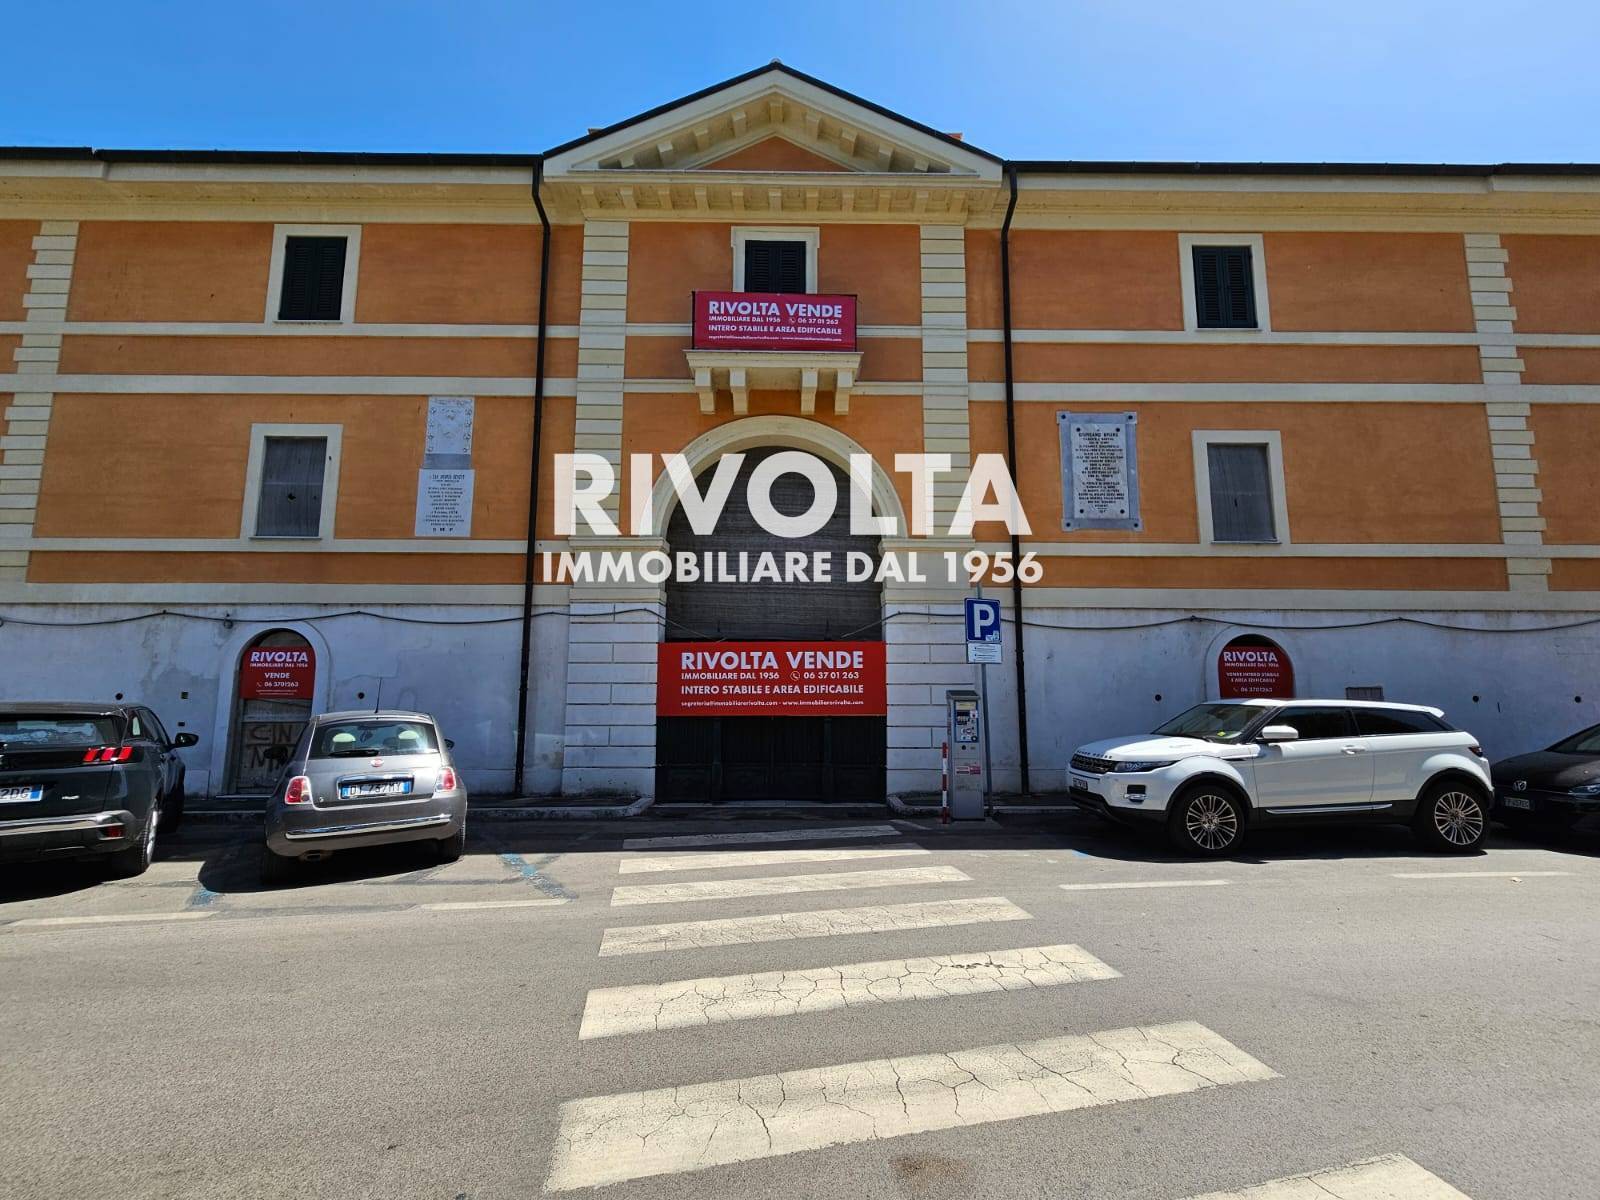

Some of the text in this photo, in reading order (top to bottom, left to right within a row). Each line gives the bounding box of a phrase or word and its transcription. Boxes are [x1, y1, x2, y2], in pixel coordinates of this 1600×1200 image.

[709, 301, 842, 317] RIVOLTA VENDE
[798, 327, 842, 335] EDIFICABILE
[973, 603, 995, 638] P
[251, 651, 308, 662] RIVOLTA
[681, 651, 864, 669] RIVOLTA VENDE
[1224, 652, 1278, 662] RIVOLTA
[681, 672, 738, 680] IMMOBILIARE
[759, 671, 780, 680] 1956
[803, 671, 816, 680] 06
[818, 671, 829, 679] 37
[830, 671, 840, 679] 01
[842, 671, 860, 679] 263
[681, 684, 864, 695] INTERO STABILE E AREA EDIFICABILE
